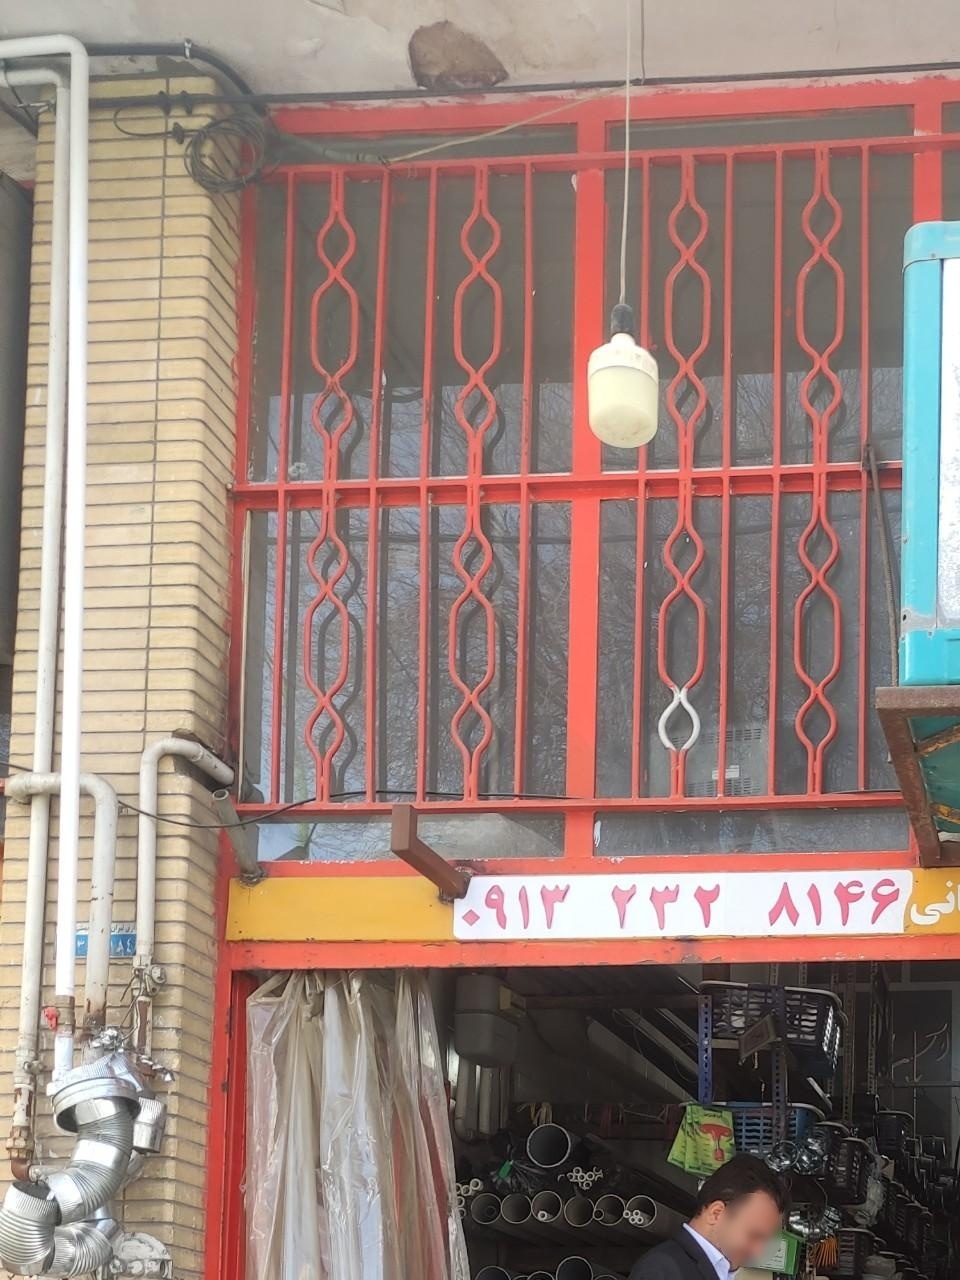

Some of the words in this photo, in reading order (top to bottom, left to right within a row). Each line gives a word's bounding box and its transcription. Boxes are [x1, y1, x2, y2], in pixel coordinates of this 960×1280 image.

[462, 884, 570, 930] ۰۹۱۳
[611, 883, 720, 930] ۲۳۲
[768, 879, 901, 927] ۸۱۴۶
